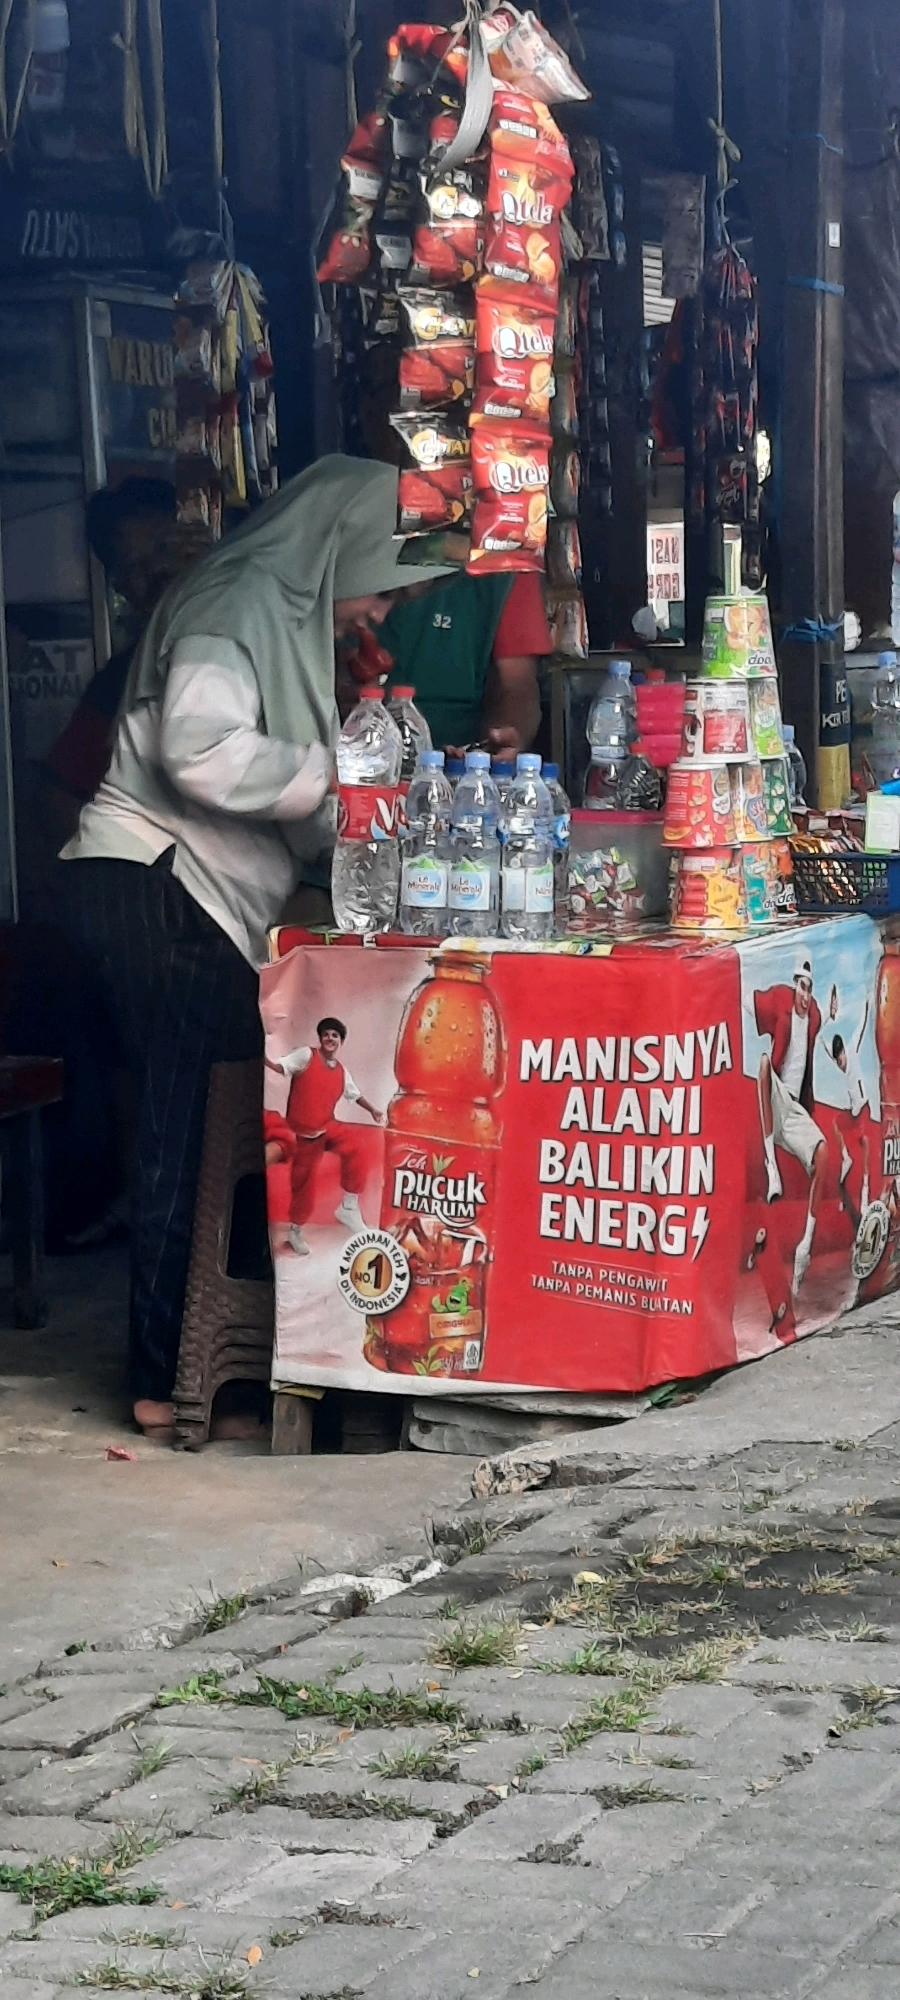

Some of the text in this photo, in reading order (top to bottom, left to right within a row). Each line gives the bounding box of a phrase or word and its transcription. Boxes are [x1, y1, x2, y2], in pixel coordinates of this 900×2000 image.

[493, 326, 553, 358] Qtela
[106, 335, 175, 388] WARU
[490, 459, 549, 493] Qtela
[432, 613, 452, 629] 32
[519, 1021, 733, 1083] MANISNYA
[560, 1085, 701, 1136] ALAMI
[394, 1147, 428, 1171] Teh
[538, 1138, 715, 1196] BALIKIN
[406, 1194, 477, 1227] HARUM
[342, 1232, 405, 1268] MINUMAN TEH
[551, 1260, 594, 1281] TANPA
[340, 1279, 404, 1311] DI INDONESIA
[531, 1273, 694, 1315] TANPA PEMANIS BUATAN
